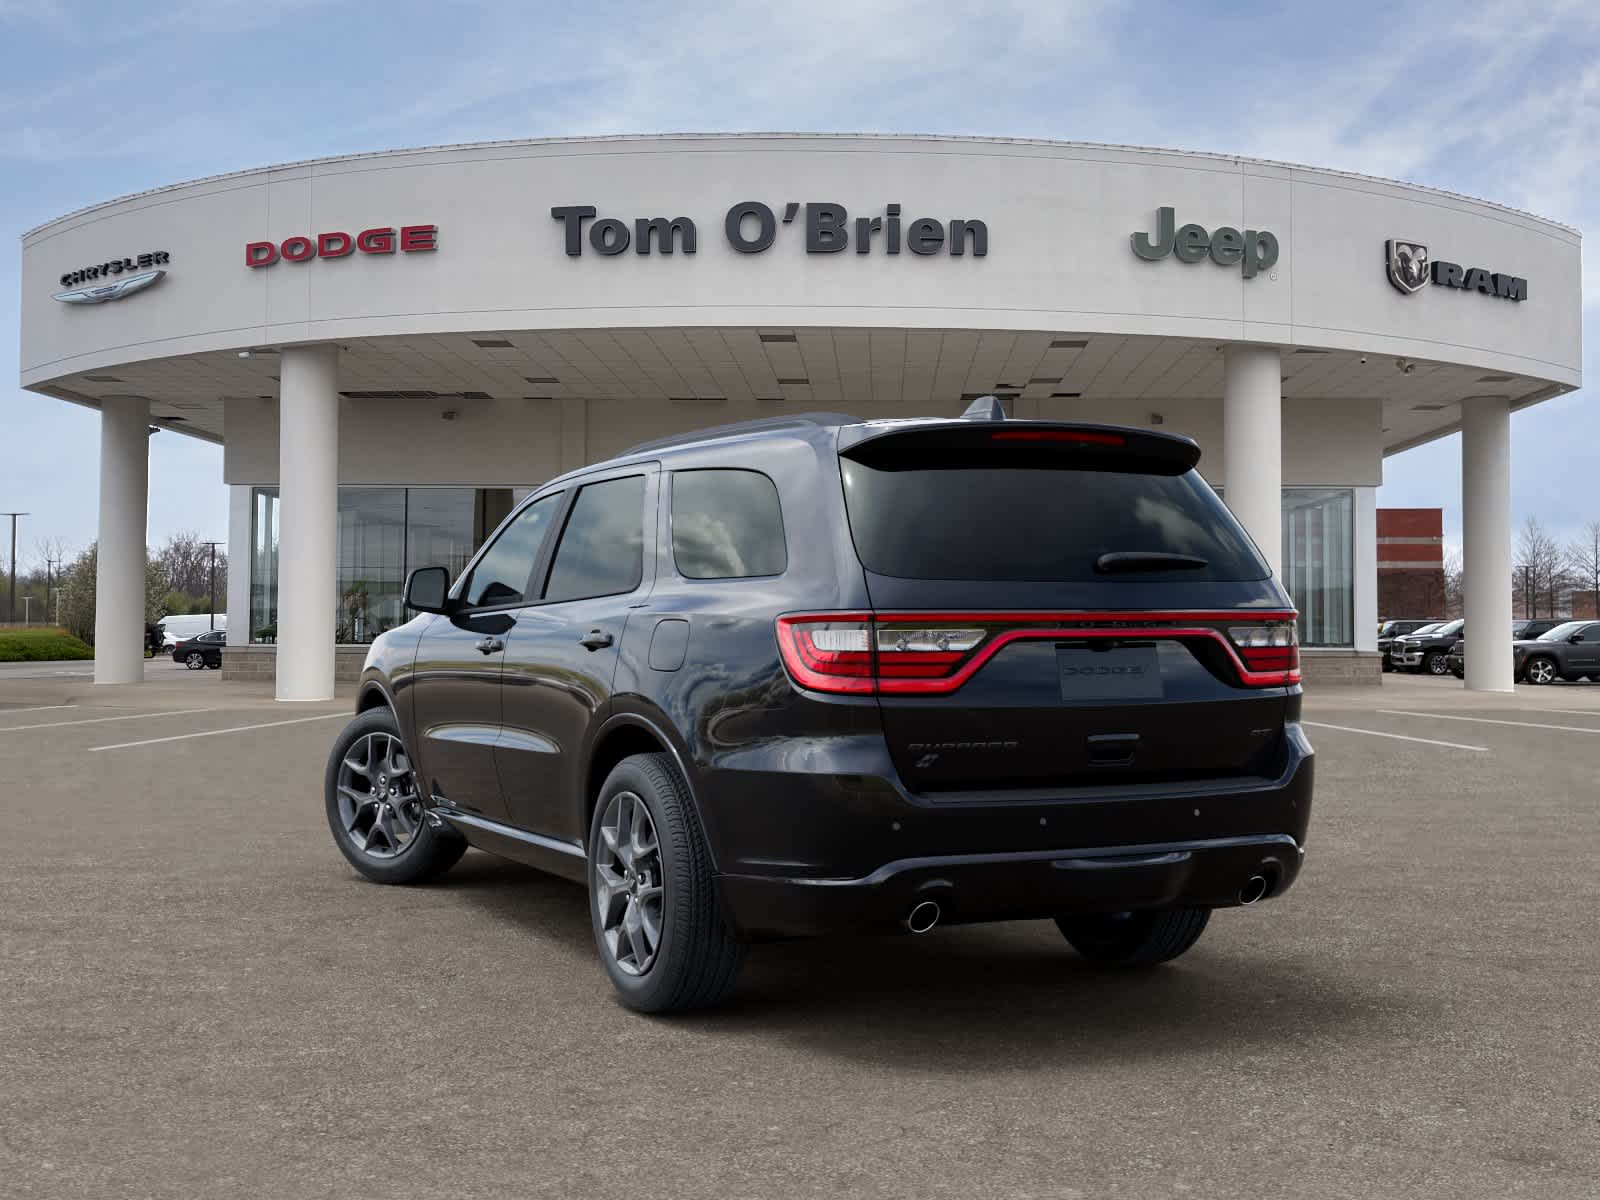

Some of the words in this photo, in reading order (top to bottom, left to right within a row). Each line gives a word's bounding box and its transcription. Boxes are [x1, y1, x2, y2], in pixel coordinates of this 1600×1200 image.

[245, 224, 438, 269] DODGE
[550, 204, 697, 256] Tom
[724, 200, 988, 257] O'Brien
[1130, 206, 1280, 278] Jeep
[59, 250, 170, 287] CHRYSLER
[1430, 260, 1528, 302] RAM
[1061, 663, 1146, 678] DODGE
